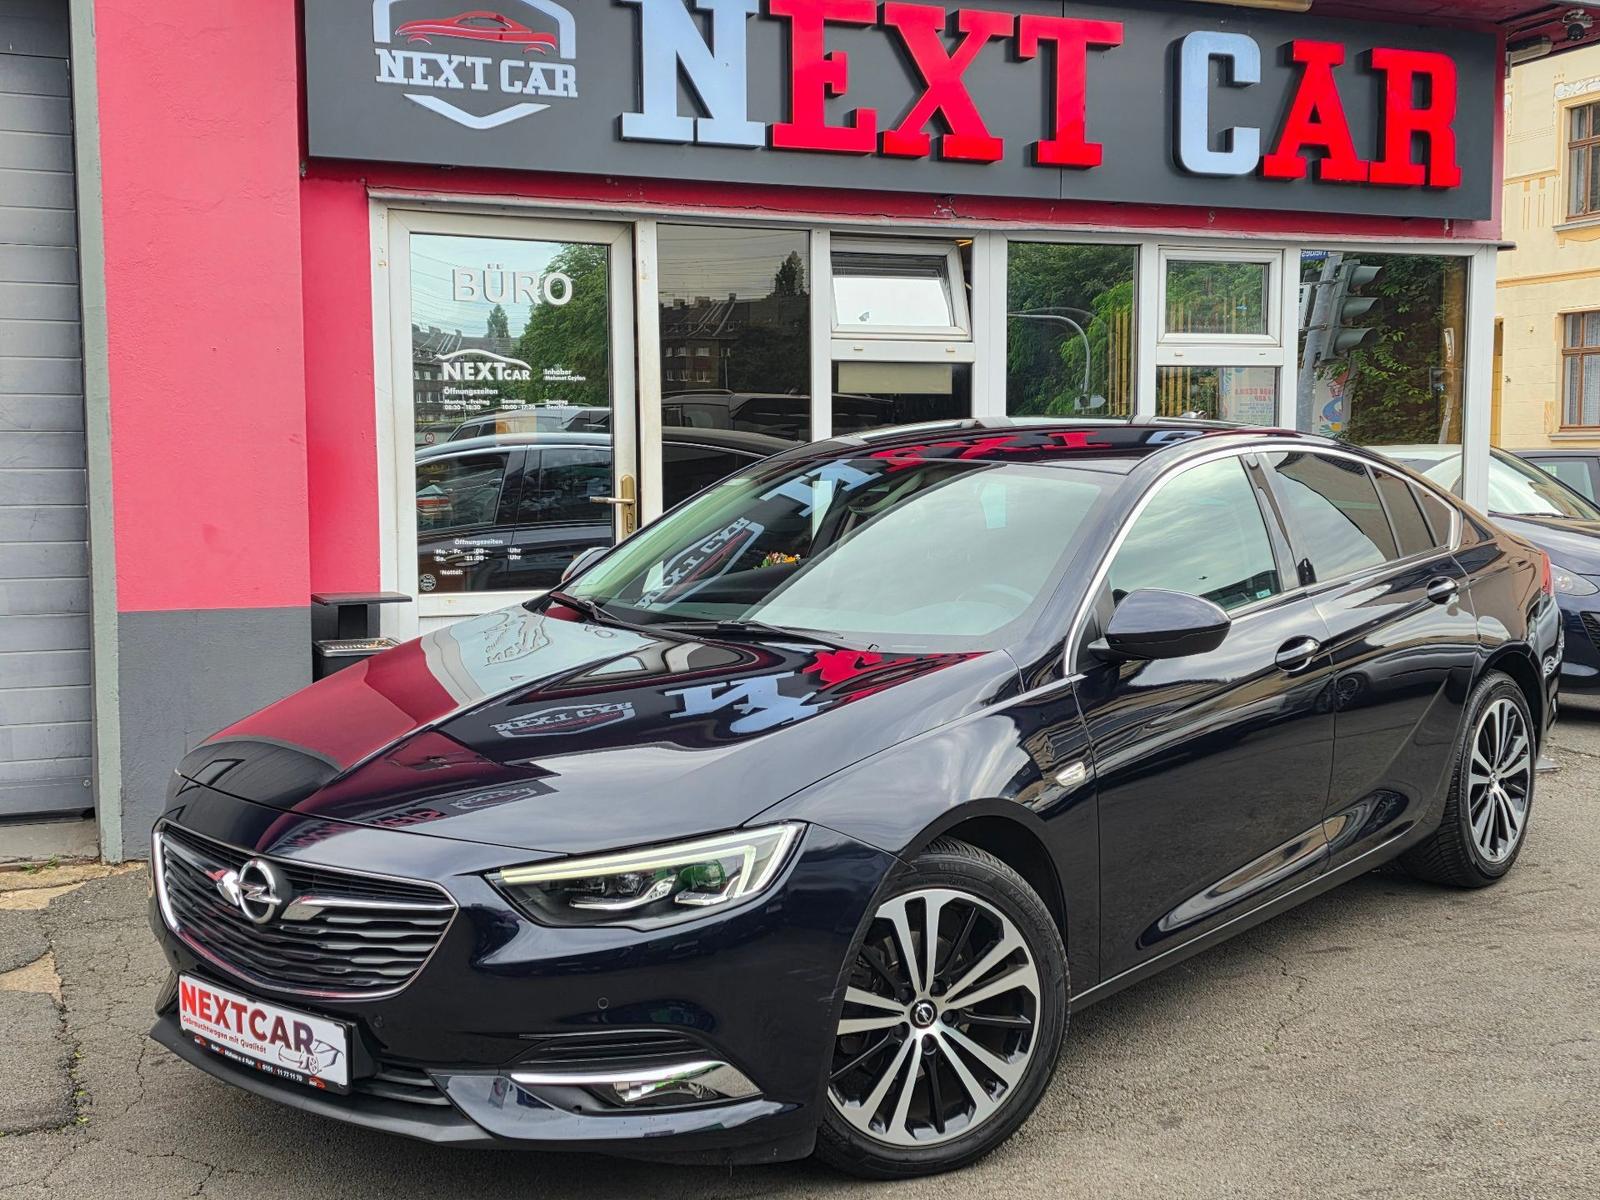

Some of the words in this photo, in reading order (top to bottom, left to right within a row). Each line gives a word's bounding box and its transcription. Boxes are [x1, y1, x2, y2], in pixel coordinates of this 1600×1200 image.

[375, 48, 491, 91] NEXT
[500, 59, 578, 98] CAR
[619, 0, 1123, 166] NEXT
[1172, 31, 1461, 188] CAR
[452, 264, 573, 305] BÜRO
[444, 387, 499, 396] Öffnungszeiten
[454, 538, 504, 546] Öffnungszeiten
[180, 981, 315, 1056] NEXTCAR
[182, 1015, 228, 1041] Gebrauchtwagen
[228, 1035, 239, 1045] mit
[240, 1038, 267, 1055] Qualität
